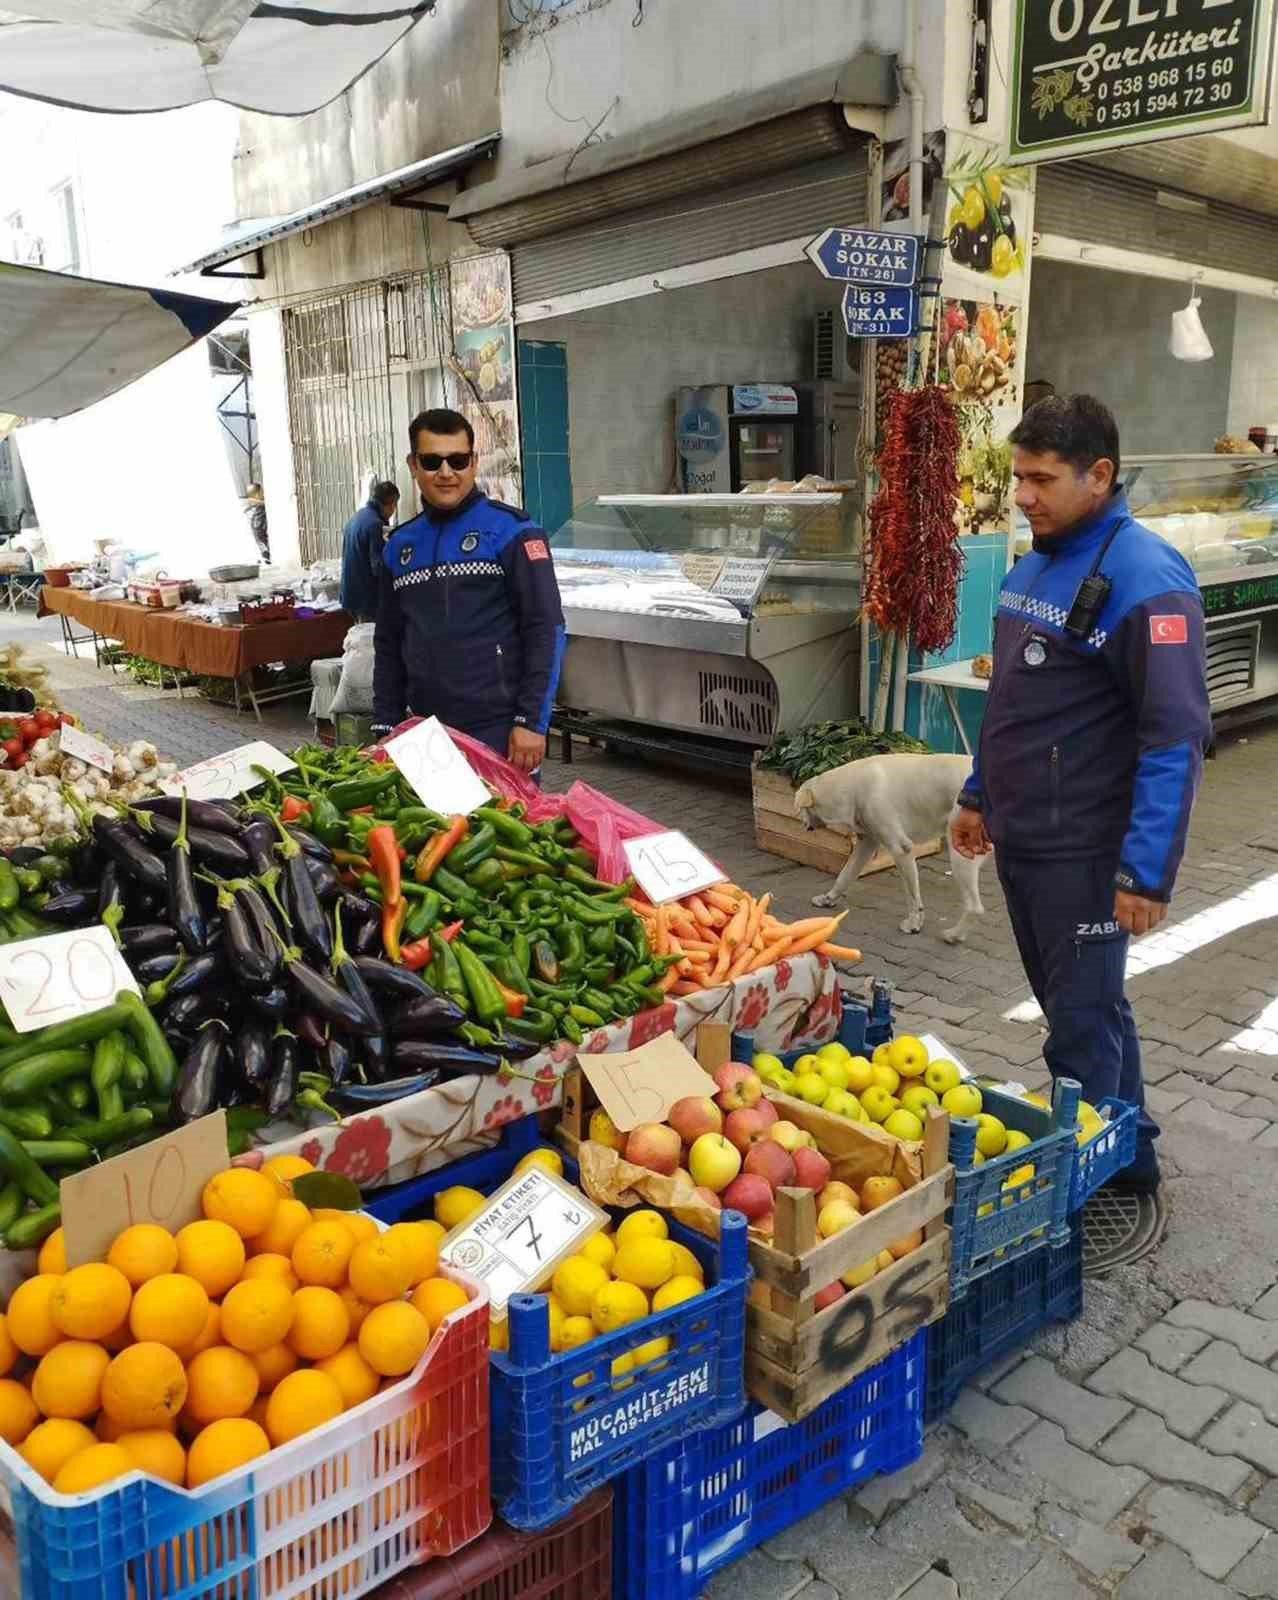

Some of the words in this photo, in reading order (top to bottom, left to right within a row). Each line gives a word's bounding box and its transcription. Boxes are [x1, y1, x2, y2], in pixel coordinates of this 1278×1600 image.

[1076, 18, 1241, 92] Şarküteri
[1098, 82, 1108, 99] 0
[1113, 76, 1143, 96] 538
[1148, 68, 1179, 89] 968
[1185, 63, 1206, 82] 15
[1211, 57, 1234, 77] 60
[1096, 106, 1106, 123] 0
[1111, 100, 1140, 120] 531
[1146, 93, 1178, 113] 594
[1183, 88, 1204, 106] 72
[1210, 82, 1232, 101] 30
[836, 250, 908, 270] SOKAK
[840, 233, 907, 253] PAZAR
[847, 266, 895, 281] (TN-26)
[638, 843, 699, 887] 15
[9, 937, 117, 1017] 20
[601, 1059, 666, 1119] 15
[123, 1144, 187, 1226] 10
[473, 1206, 503, 1236] FİYAT
[502, 1173, 541, 1210] ETİKETİ
[505, 1214, 543, 1262] 7
[570, 1362, 709, 1449] MÜCAHİT-ZEKİ
[570, 1437, 603, 1462] HAL
